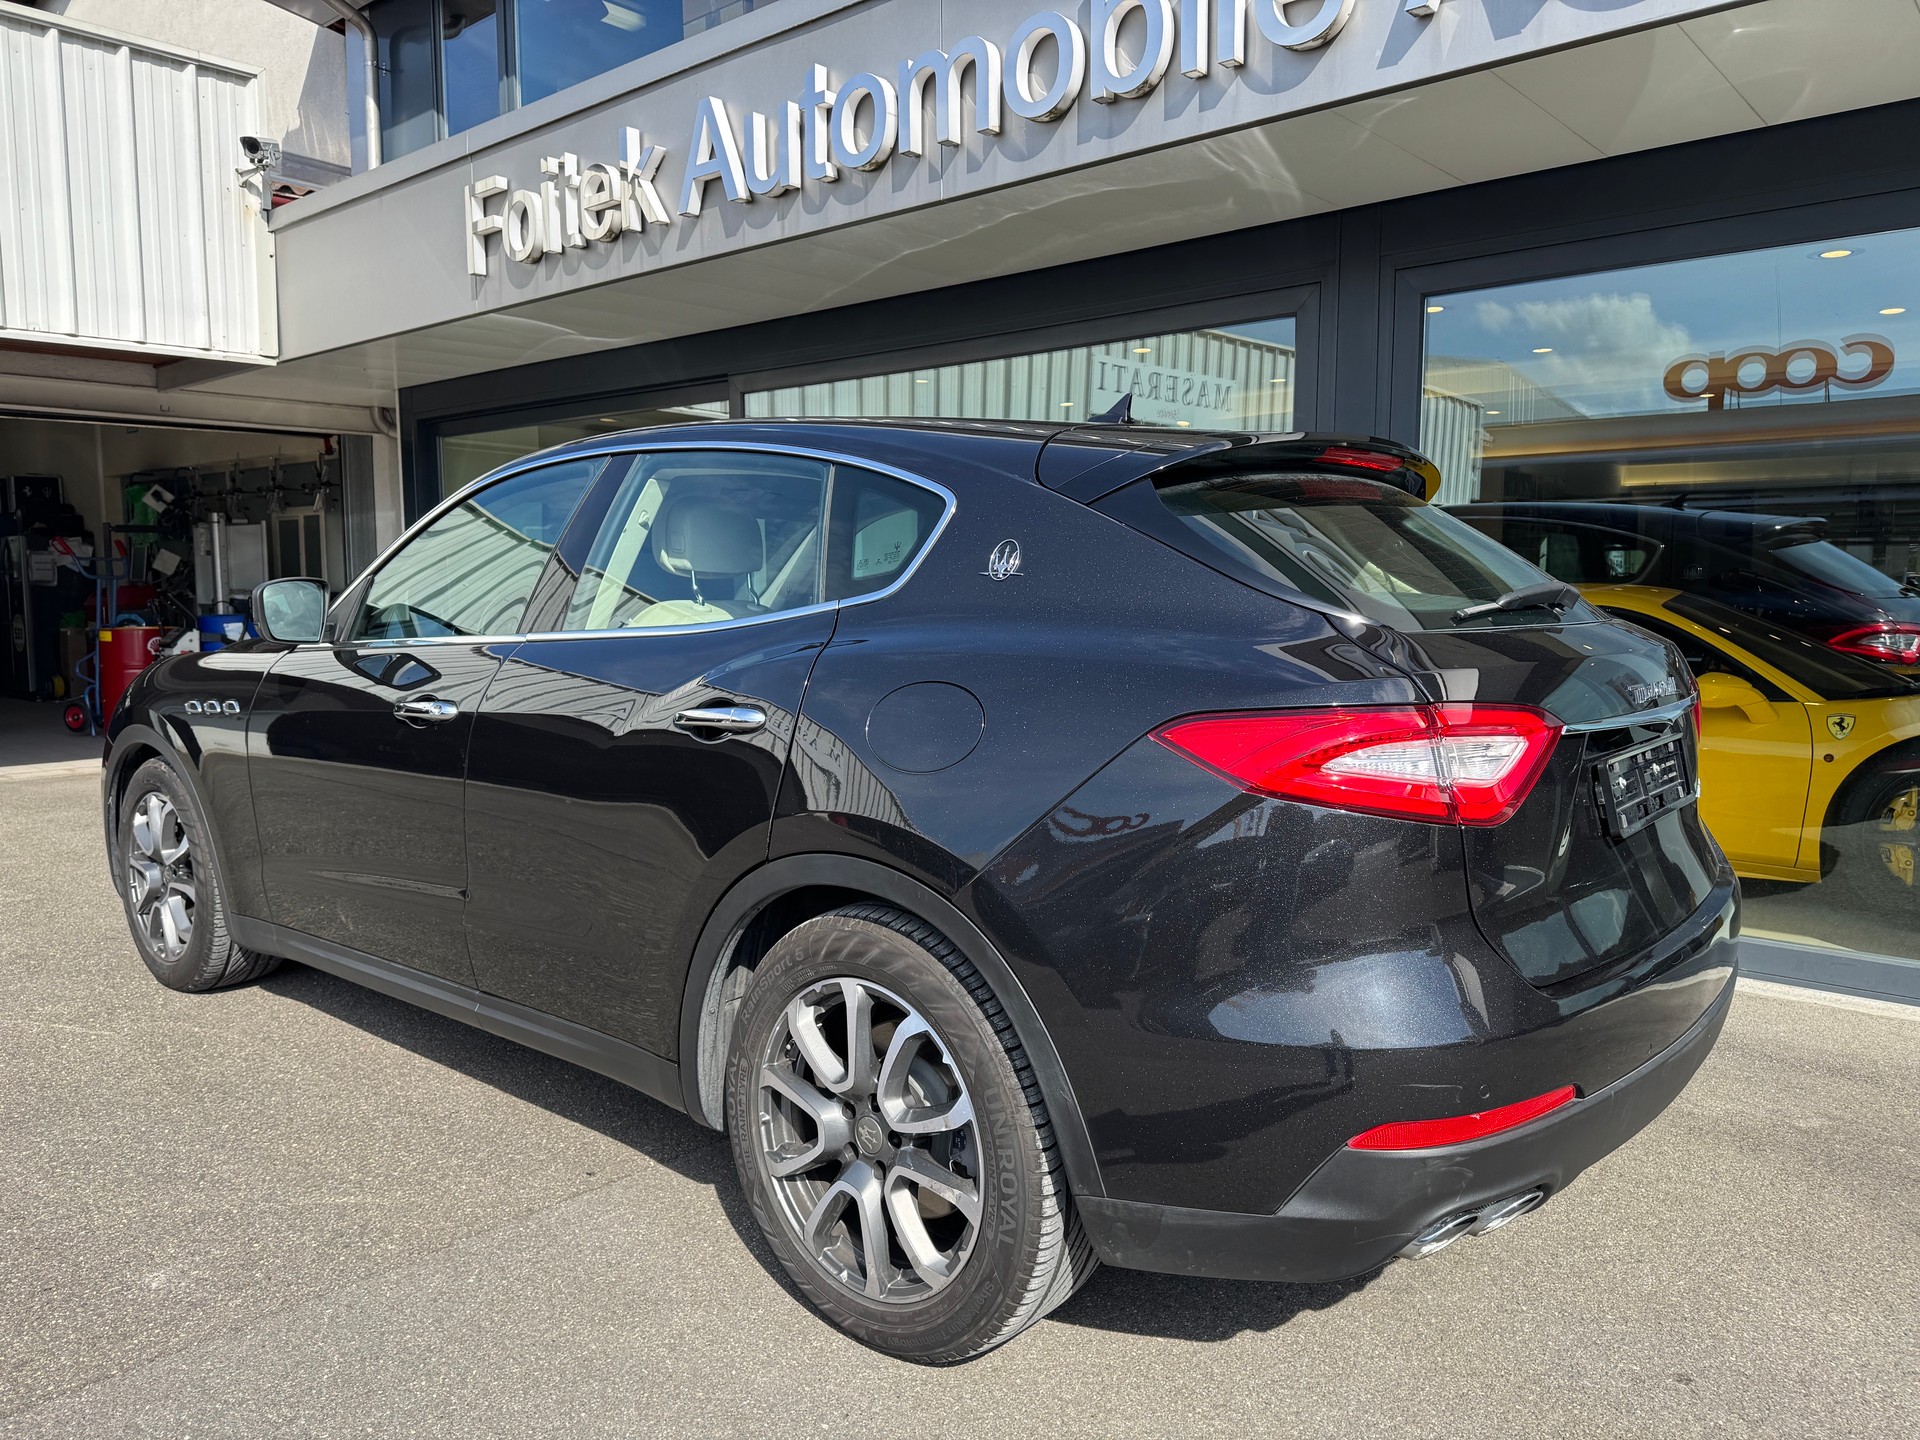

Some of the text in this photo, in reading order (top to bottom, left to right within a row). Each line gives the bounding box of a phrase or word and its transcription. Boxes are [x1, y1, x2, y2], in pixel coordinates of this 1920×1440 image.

[465, 126, 670, 277] Foitek
[738, 1064, 752, 1171] THE RAIN TYRE
[983, 1087, 1018, 1248] UNIROYAL
[986, 1141, 996, 1183] RAIN
[986, 1192, 997, 1231] TYRE
